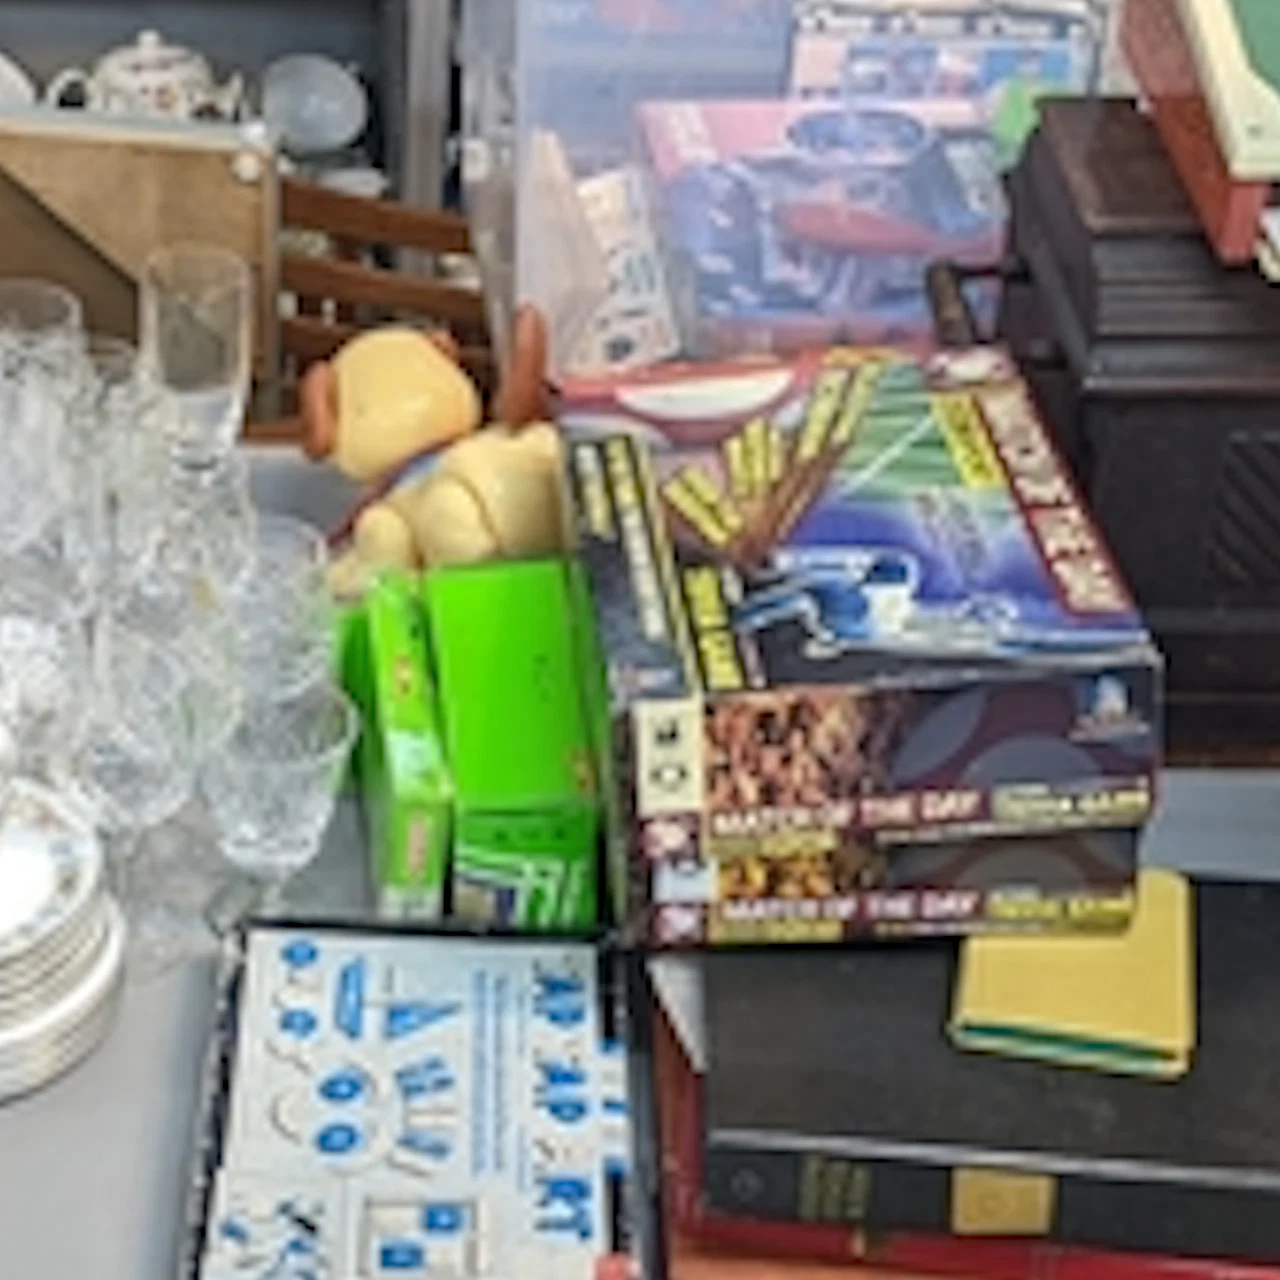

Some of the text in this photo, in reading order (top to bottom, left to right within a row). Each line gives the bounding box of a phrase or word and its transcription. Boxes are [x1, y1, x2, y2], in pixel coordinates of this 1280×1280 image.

[1028, 506, 1100, 558] THE
[1054, 557, 1130, 613] DAY
[859, 794, 915, 826] THE
[921, 789, 982, 823] DAY
[866, 888, 913, 919] THE
[921, 886, 980, 918] DAY
